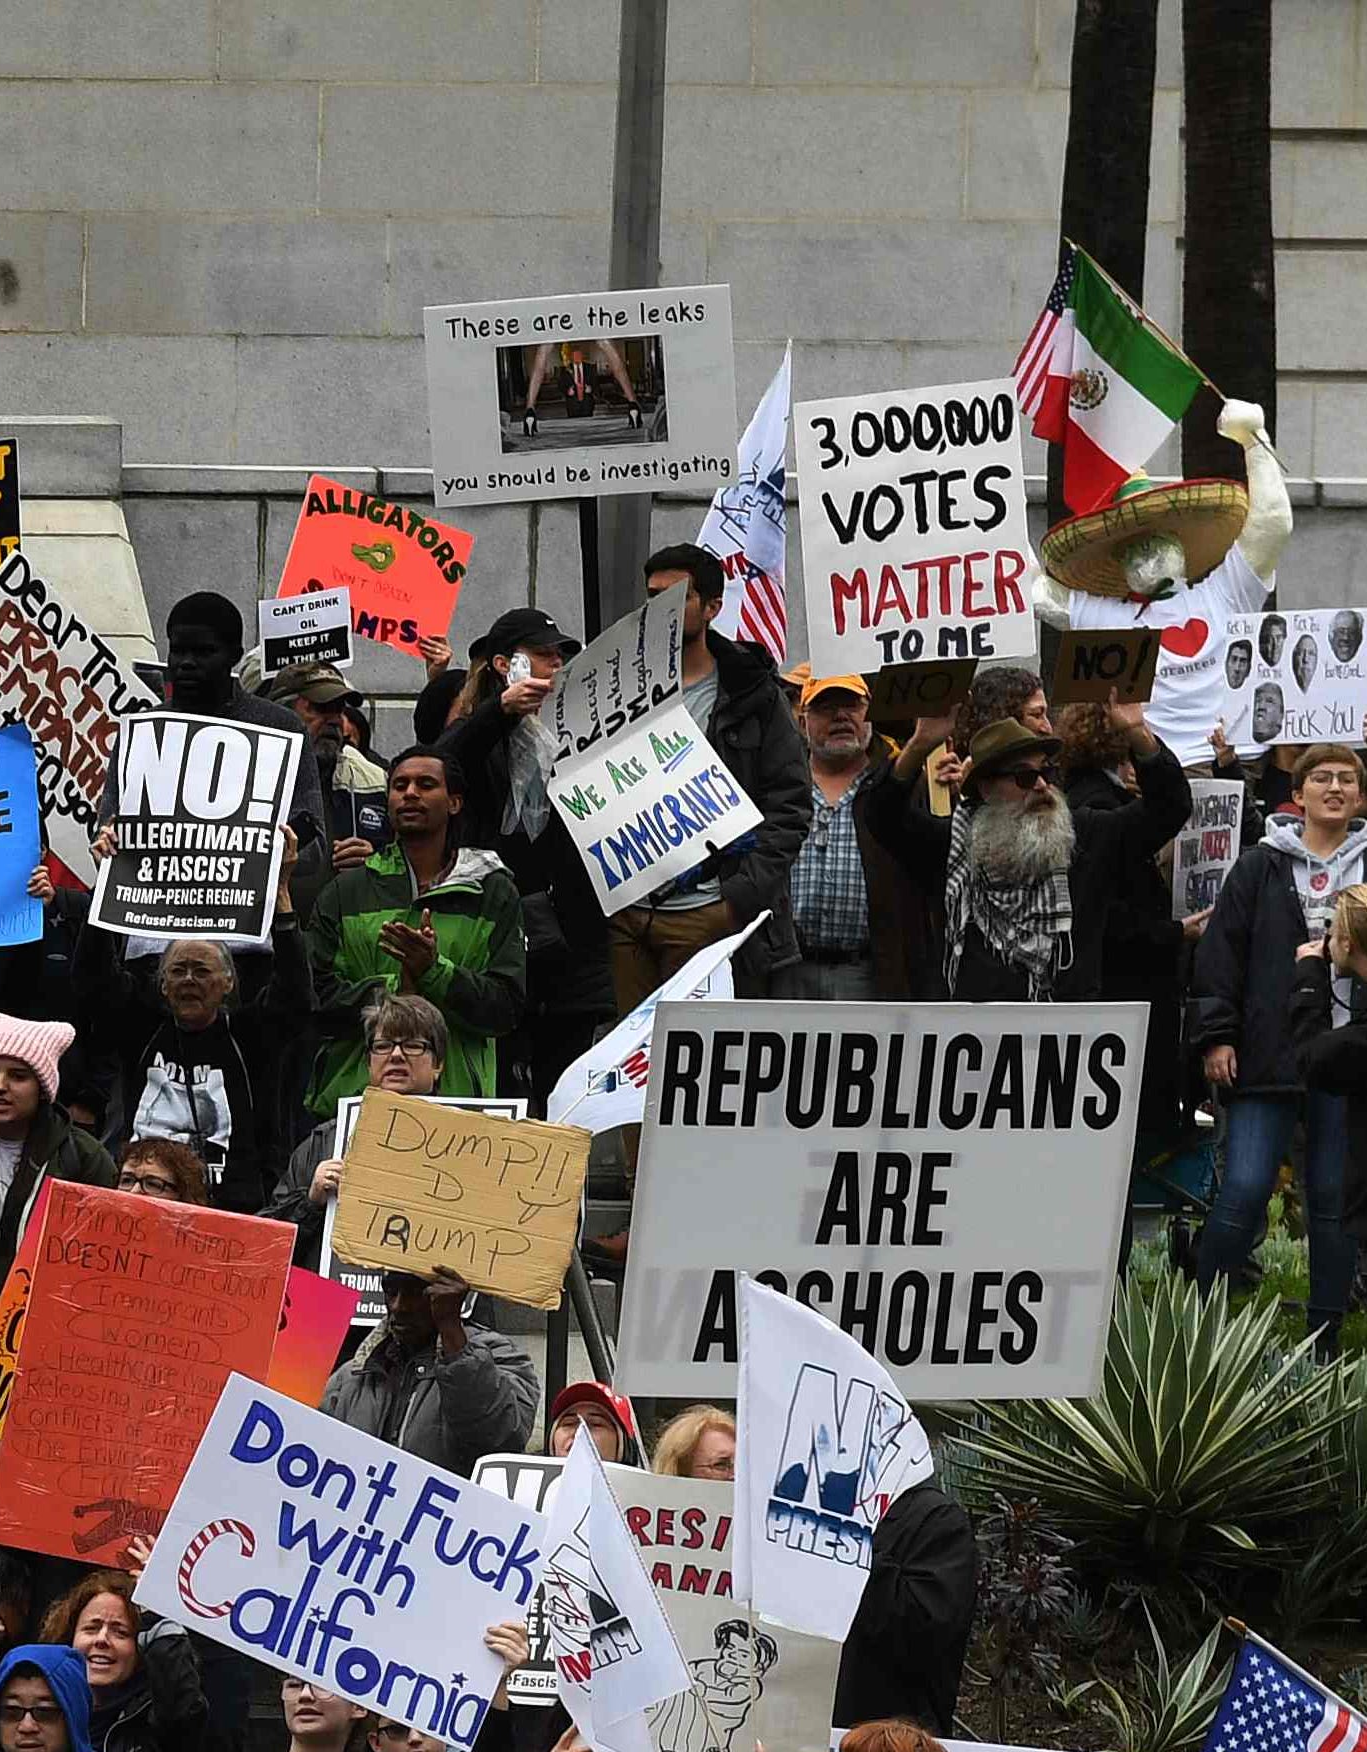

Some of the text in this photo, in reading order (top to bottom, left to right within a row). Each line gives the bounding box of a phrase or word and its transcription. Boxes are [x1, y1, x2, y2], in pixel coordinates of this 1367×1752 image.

[446, 302, 706, 340] These are the leaks
[811, 394, 1015, 469] 3,000,000
[442, 456, 731, 494] you should be investigating
[822, 466, 1013, 544] VOTES
[305, 488, 466, 585] ALLIGATORS
[273, 598, 339, 616] CAN'T DRINK
[831, 551, 1026, 635] MATTER
[289, 634, 329, 648] KEEP IT
[876, 622, 994, 664] TO ME
[1072, 635, 1155, 697] NO!
[119, 721, 288, 823] NO!
[117, 823, 272, 853] ILLEGITIMATE
[588, 765, 741, 891] IMMIGRANTS
[117, 885, 255, 907] TRUMP-PENCE REGIME
[137, 856, 245, 882] & FASCIST
[125, 912, 236, 929] RefuseFascism.org
[659, 1030, 1127, 1130] REPUBLICANS
[815, 1151, 953, 1246] ARE
[229, 1401, 540, 1606] Don't Fuck
[277, 1501, 418, 1608] with
[178, 1518, 490, 1749] California
